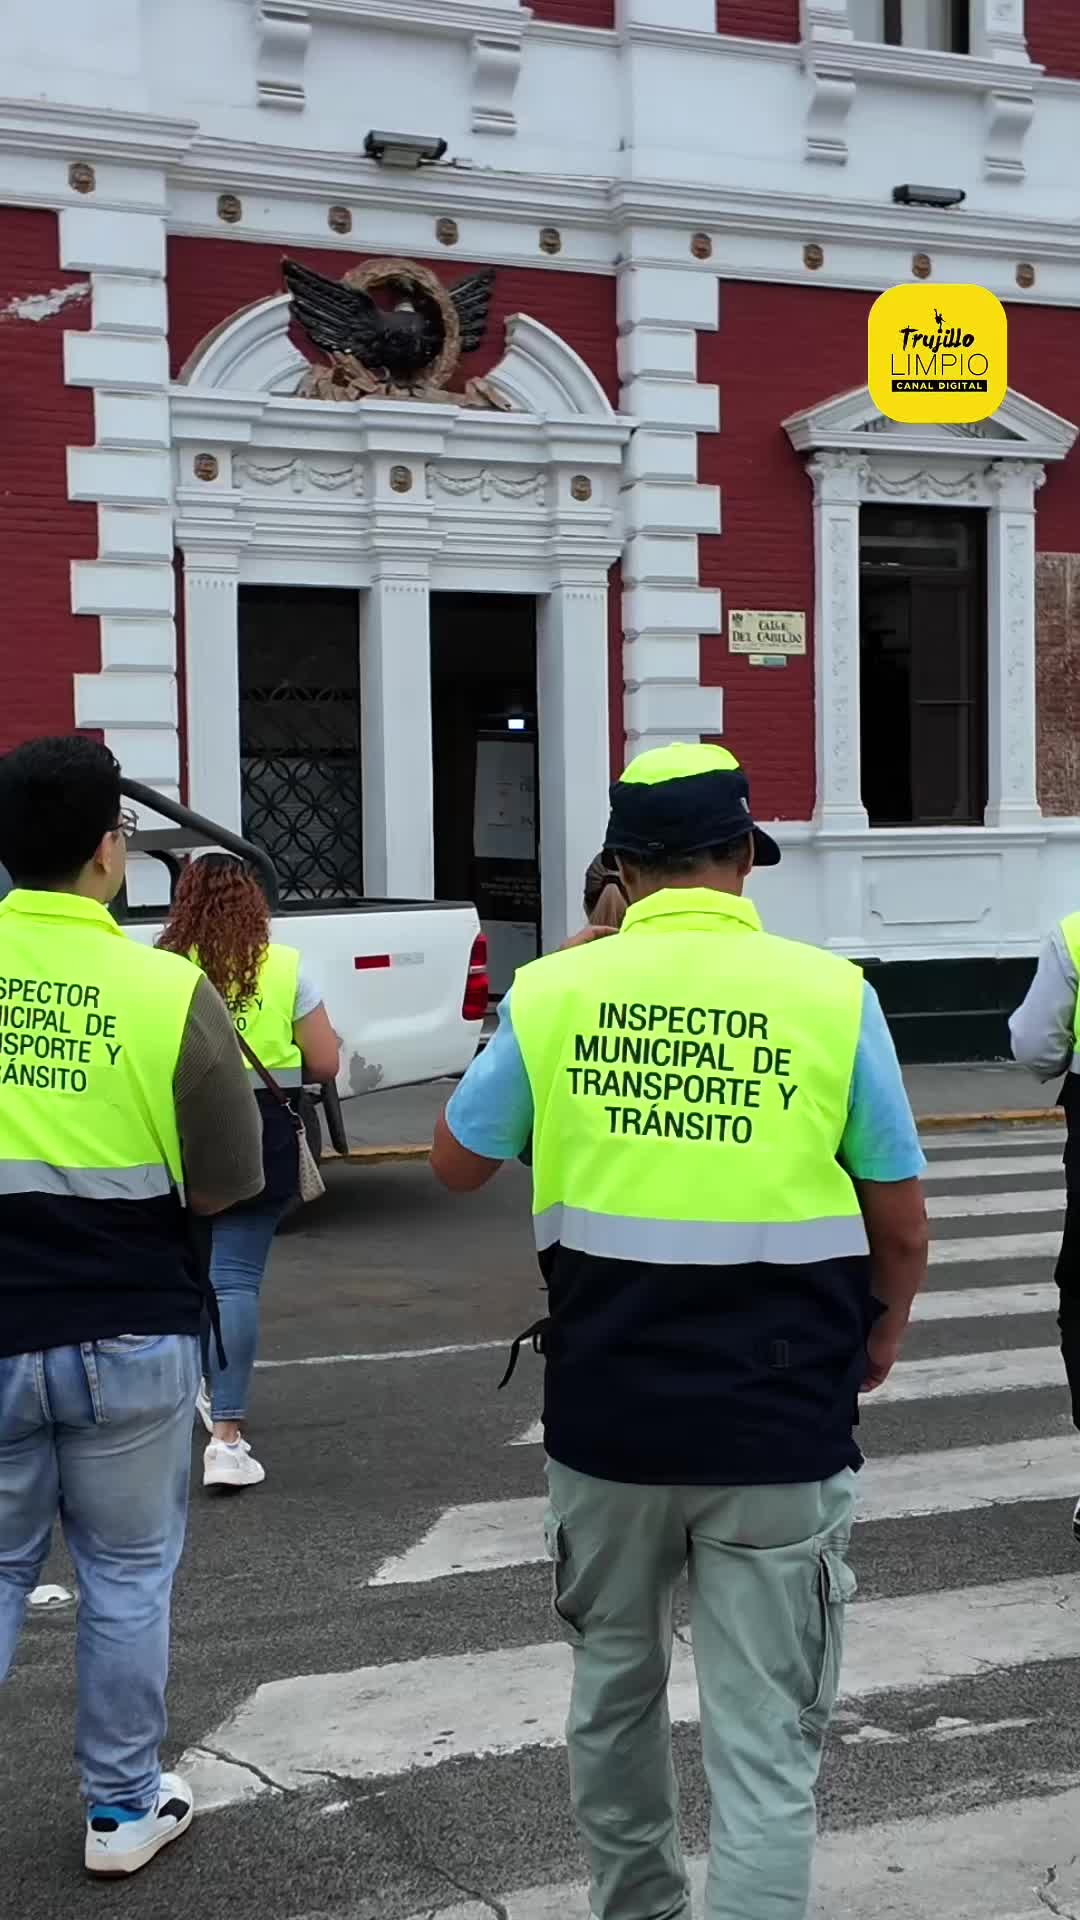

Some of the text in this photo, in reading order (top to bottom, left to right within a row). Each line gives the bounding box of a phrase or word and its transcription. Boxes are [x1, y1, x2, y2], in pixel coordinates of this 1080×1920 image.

[732, 630, 752, 642] DEL
[0, 976, 100, 1008] SPECTOR
[0, 1005, 117, 1038] ICIPAL DE
[599, 1002, 768, 1040] INSPECTOR
[0, 1032, 122, 1066] SPORTE Y
[575, 1034, 792, 1076] MUNICIPAL DE
[0, 1057, 87, 1092] ÁNSITO
[566, 1067, 798, 1110] TRANSPORTE Y
[604, 1103, 753, 1144] TRÁNSITO
